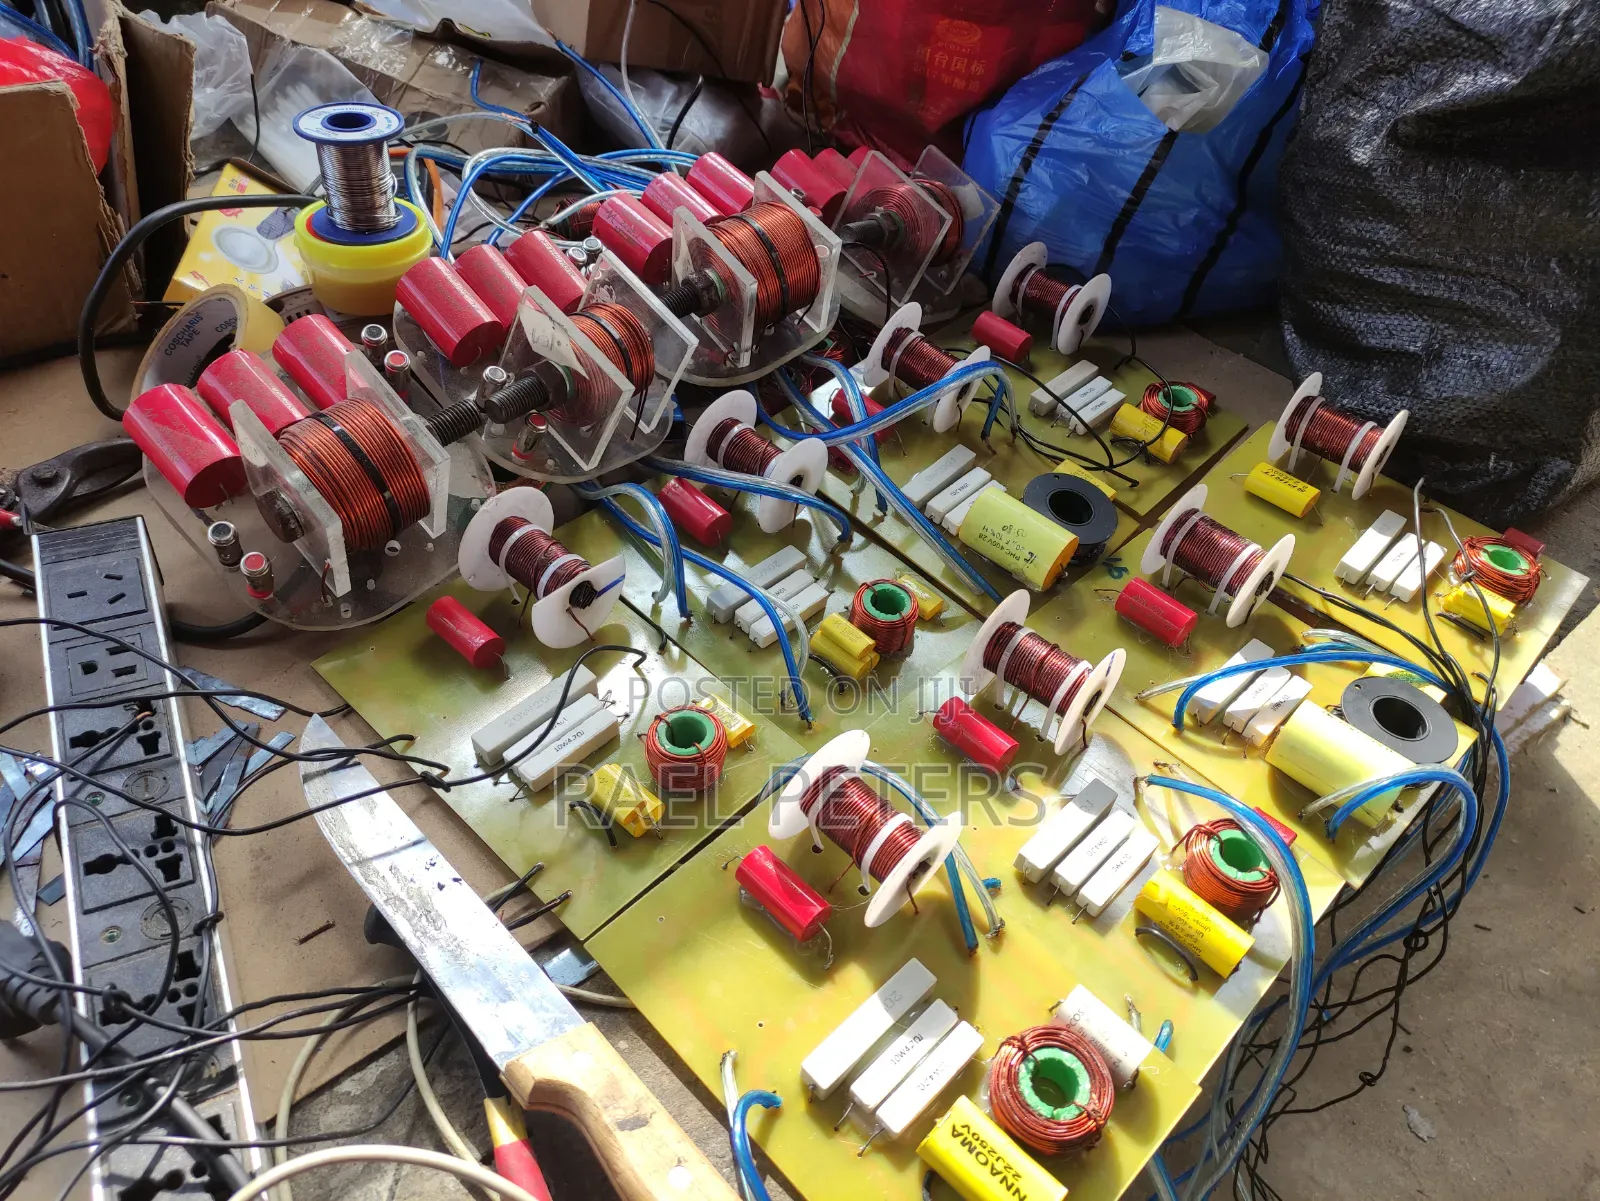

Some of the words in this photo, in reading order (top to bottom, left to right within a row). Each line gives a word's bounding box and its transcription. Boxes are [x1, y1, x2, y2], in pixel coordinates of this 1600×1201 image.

[164, 312, 204, 356] COSCHARIS
[180, 328, 201, 348] TAPE
[961, 1124, 1022, 1182] 22J250V
